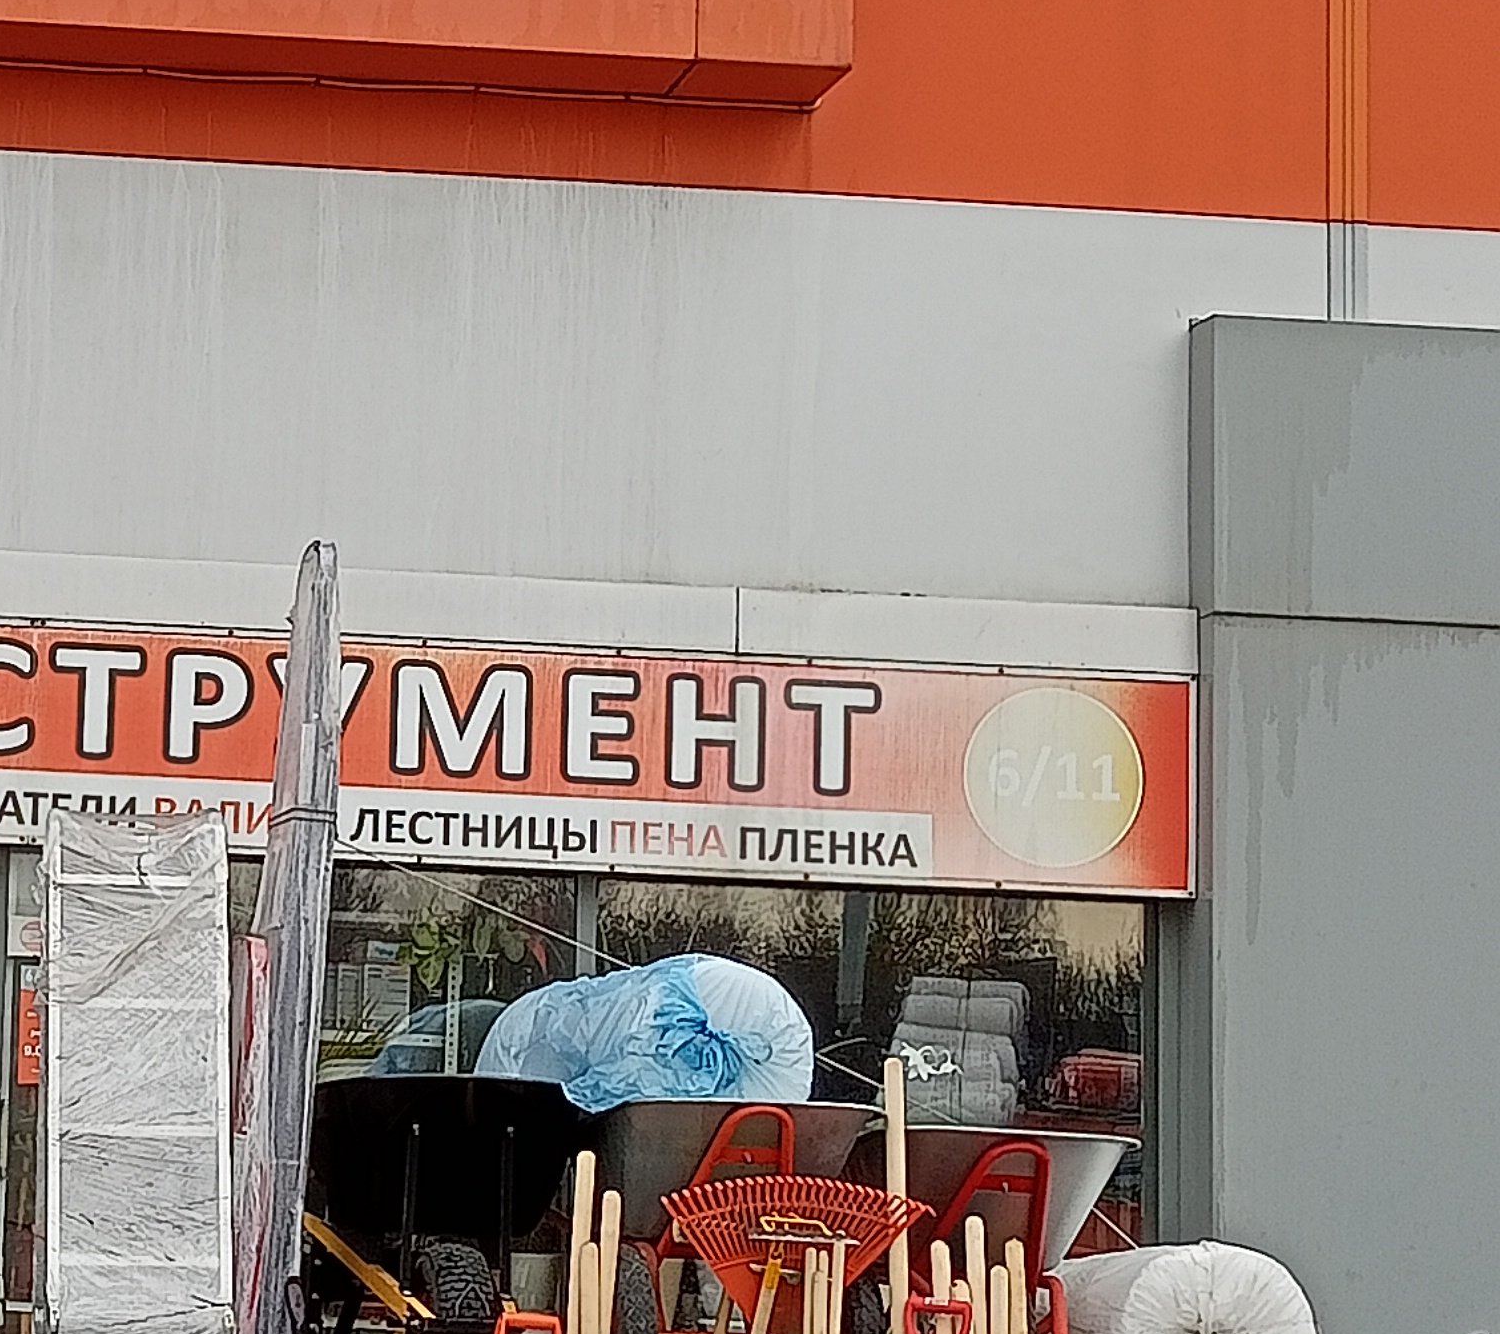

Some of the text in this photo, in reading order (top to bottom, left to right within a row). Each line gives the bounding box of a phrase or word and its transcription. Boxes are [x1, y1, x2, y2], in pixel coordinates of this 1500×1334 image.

[988, 745, 1122, 807] 6/11
[350, 808, 598, 859] ЛЕСТНИЦЫ
[610, 820, 728, 858] ПЕНА
[738, 825, 919, 869] ПЛЕНКА
